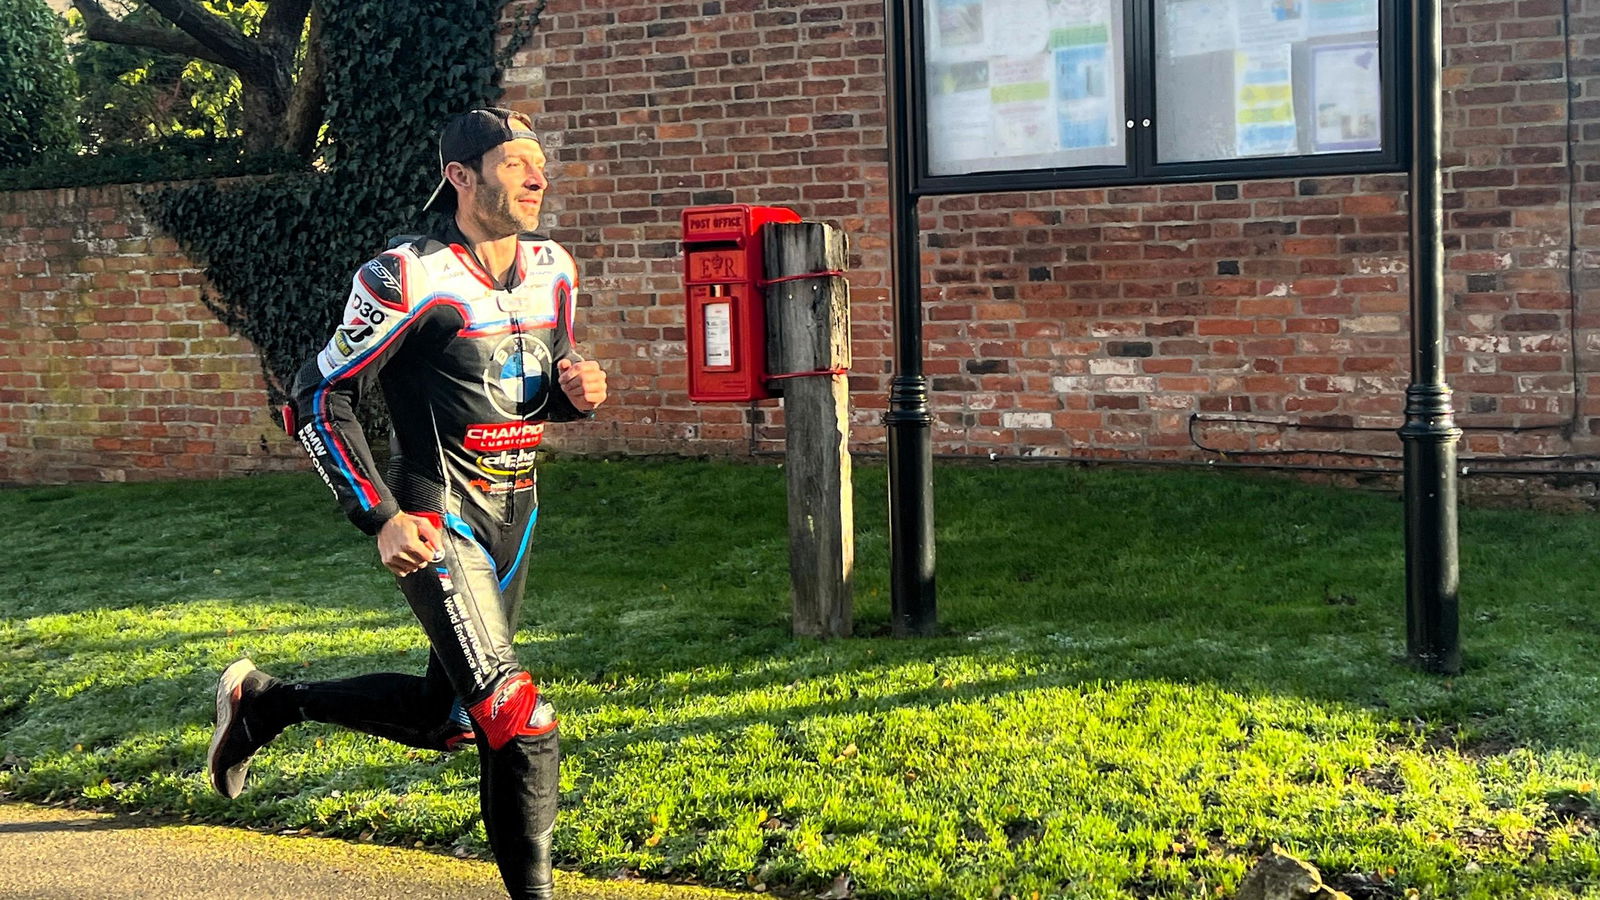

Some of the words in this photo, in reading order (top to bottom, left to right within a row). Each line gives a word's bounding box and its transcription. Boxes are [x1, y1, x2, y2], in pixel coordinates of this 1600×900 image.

[690, 218, 711, 230] POST
[713, 217, 742, 229] OFFICE
[368, 259, 403, 295] RST
[495, 338, 546, 366] BMW
[303, 422, 328, 457] BMW
[443, 596, 461, 624] World
[453, 622, 477, 669] Endurance
